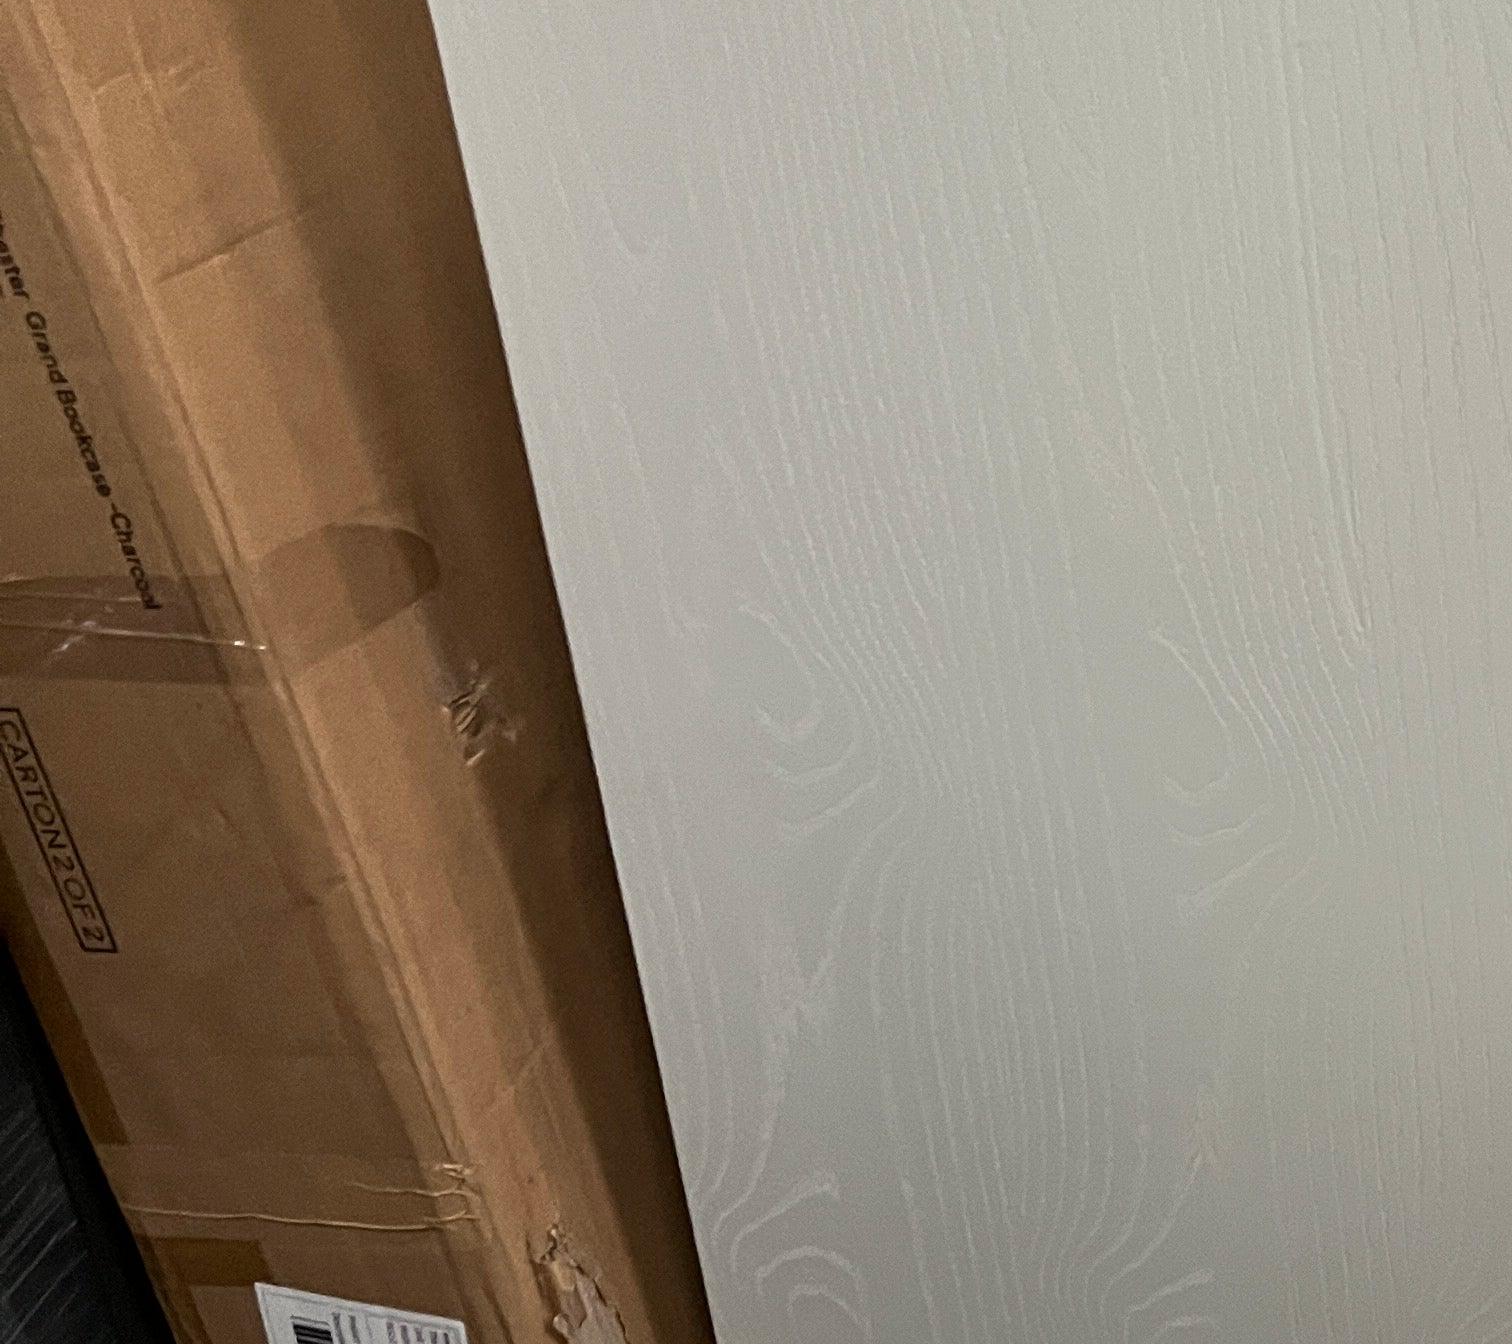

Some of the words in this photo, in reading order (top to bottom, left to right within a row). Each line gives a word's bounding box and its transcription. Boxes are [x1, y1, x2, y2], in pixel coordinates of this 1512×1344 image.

[26, 311, 68, 384] Grand
[56, 388, 111, 497] Bookcase
[0, 720, 67, 849] CARTON
[52, 856, 76, 872] 2
[63, 877, 97, 922] OF
